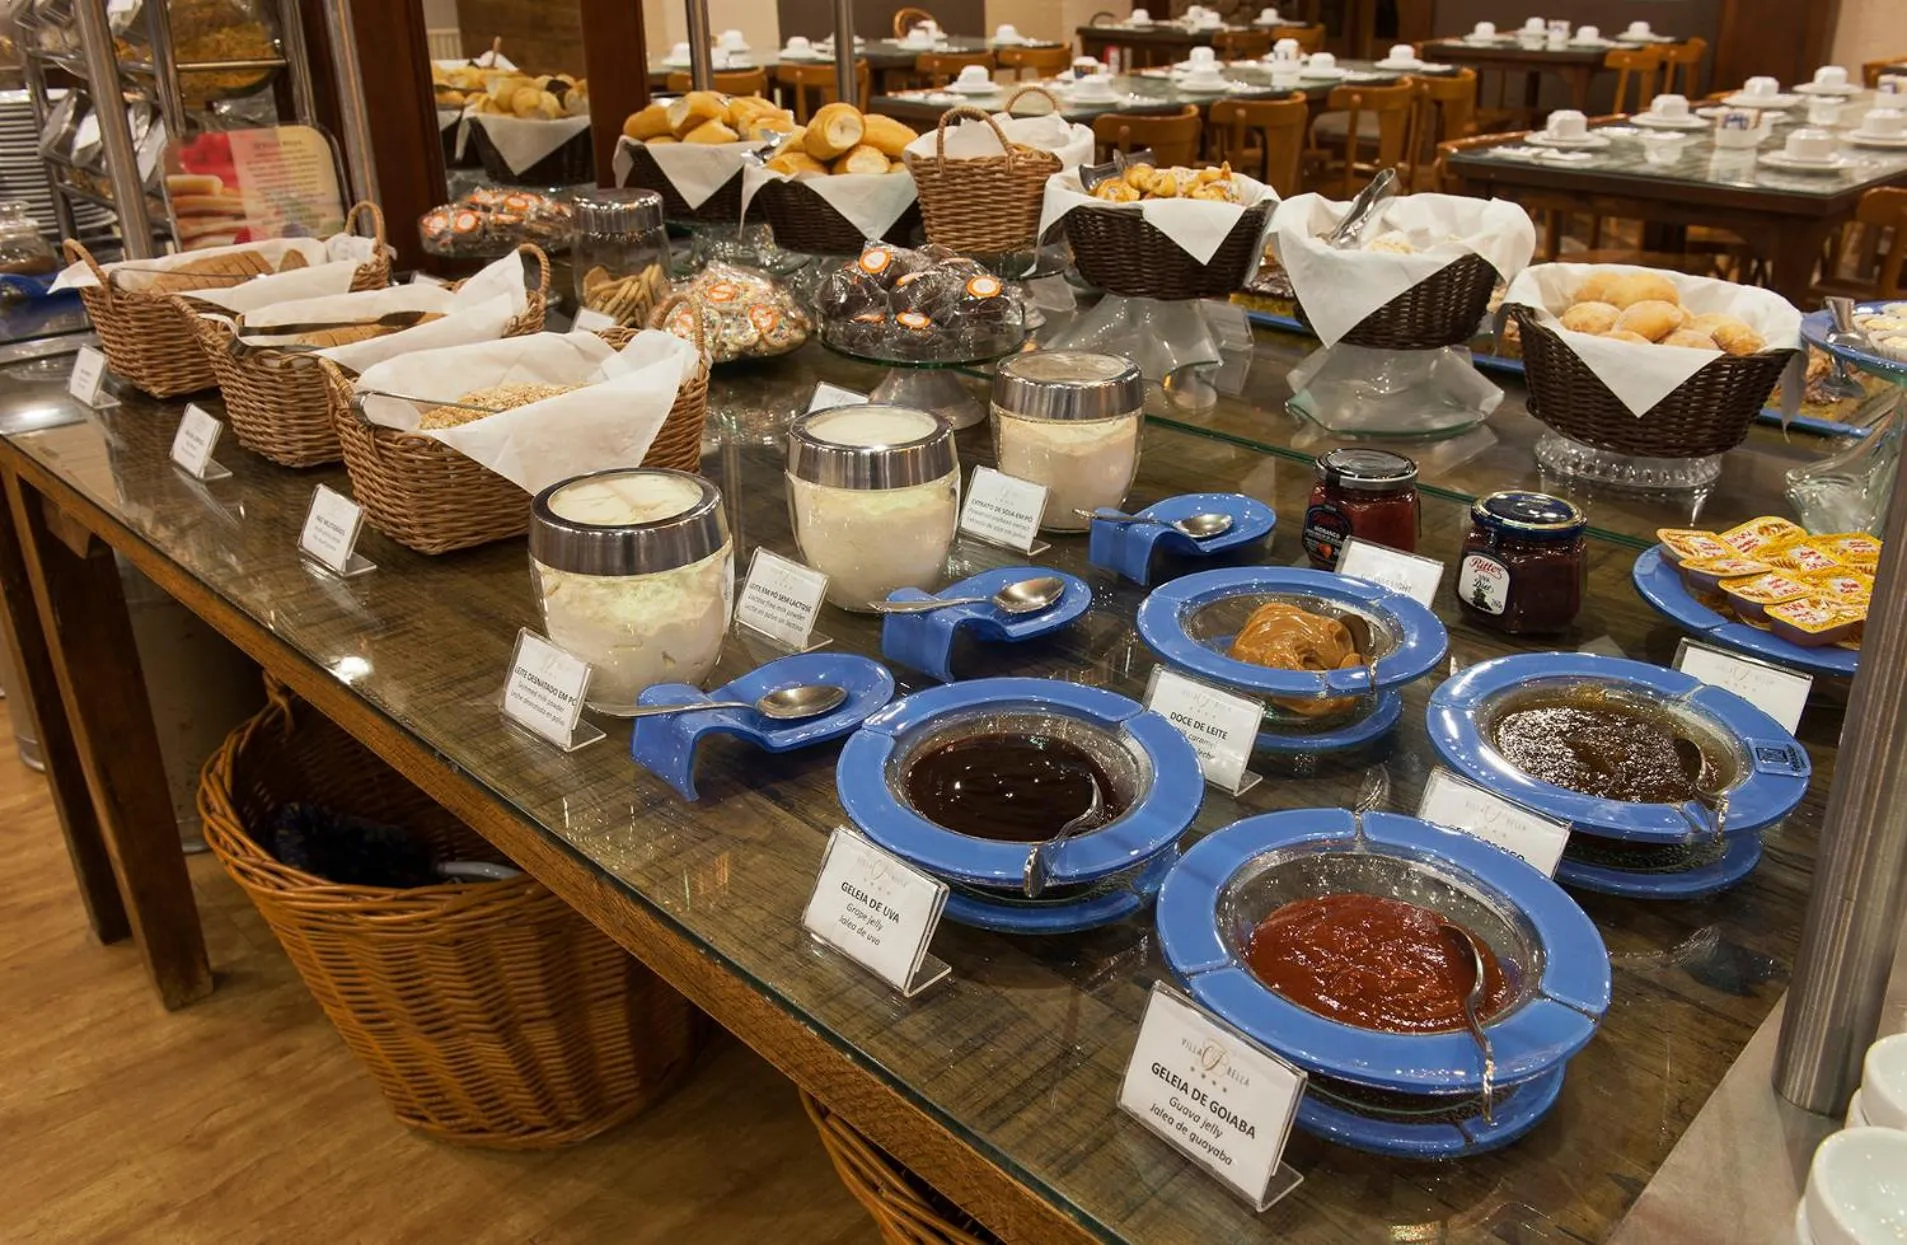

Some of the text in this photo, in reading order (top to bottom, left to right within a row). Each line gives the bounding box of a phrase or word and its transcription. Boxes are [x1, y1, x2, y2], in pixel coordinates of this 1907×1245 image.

[1170, 712, 1192, 728] DOCE
[1194, 720, 1205, 732] DE
[1206, 725, 1228, 740] LEITE
[841, 881, 900, 924] GELEIA DE UVA
[846, 903, 885, 932] Grape jelly
[856, 926, 866, 938] de
[866, 934, 881, 947] uva
[1226, 1067, 1251, 1088] BELLA
[1151, 1062, 1256, 1140] GELEIA DE GOIABA
[1168, 1096, 1224, 1141] Guava jelly
[1150, 1102, 1234, 1167] Jalea de guayaba
